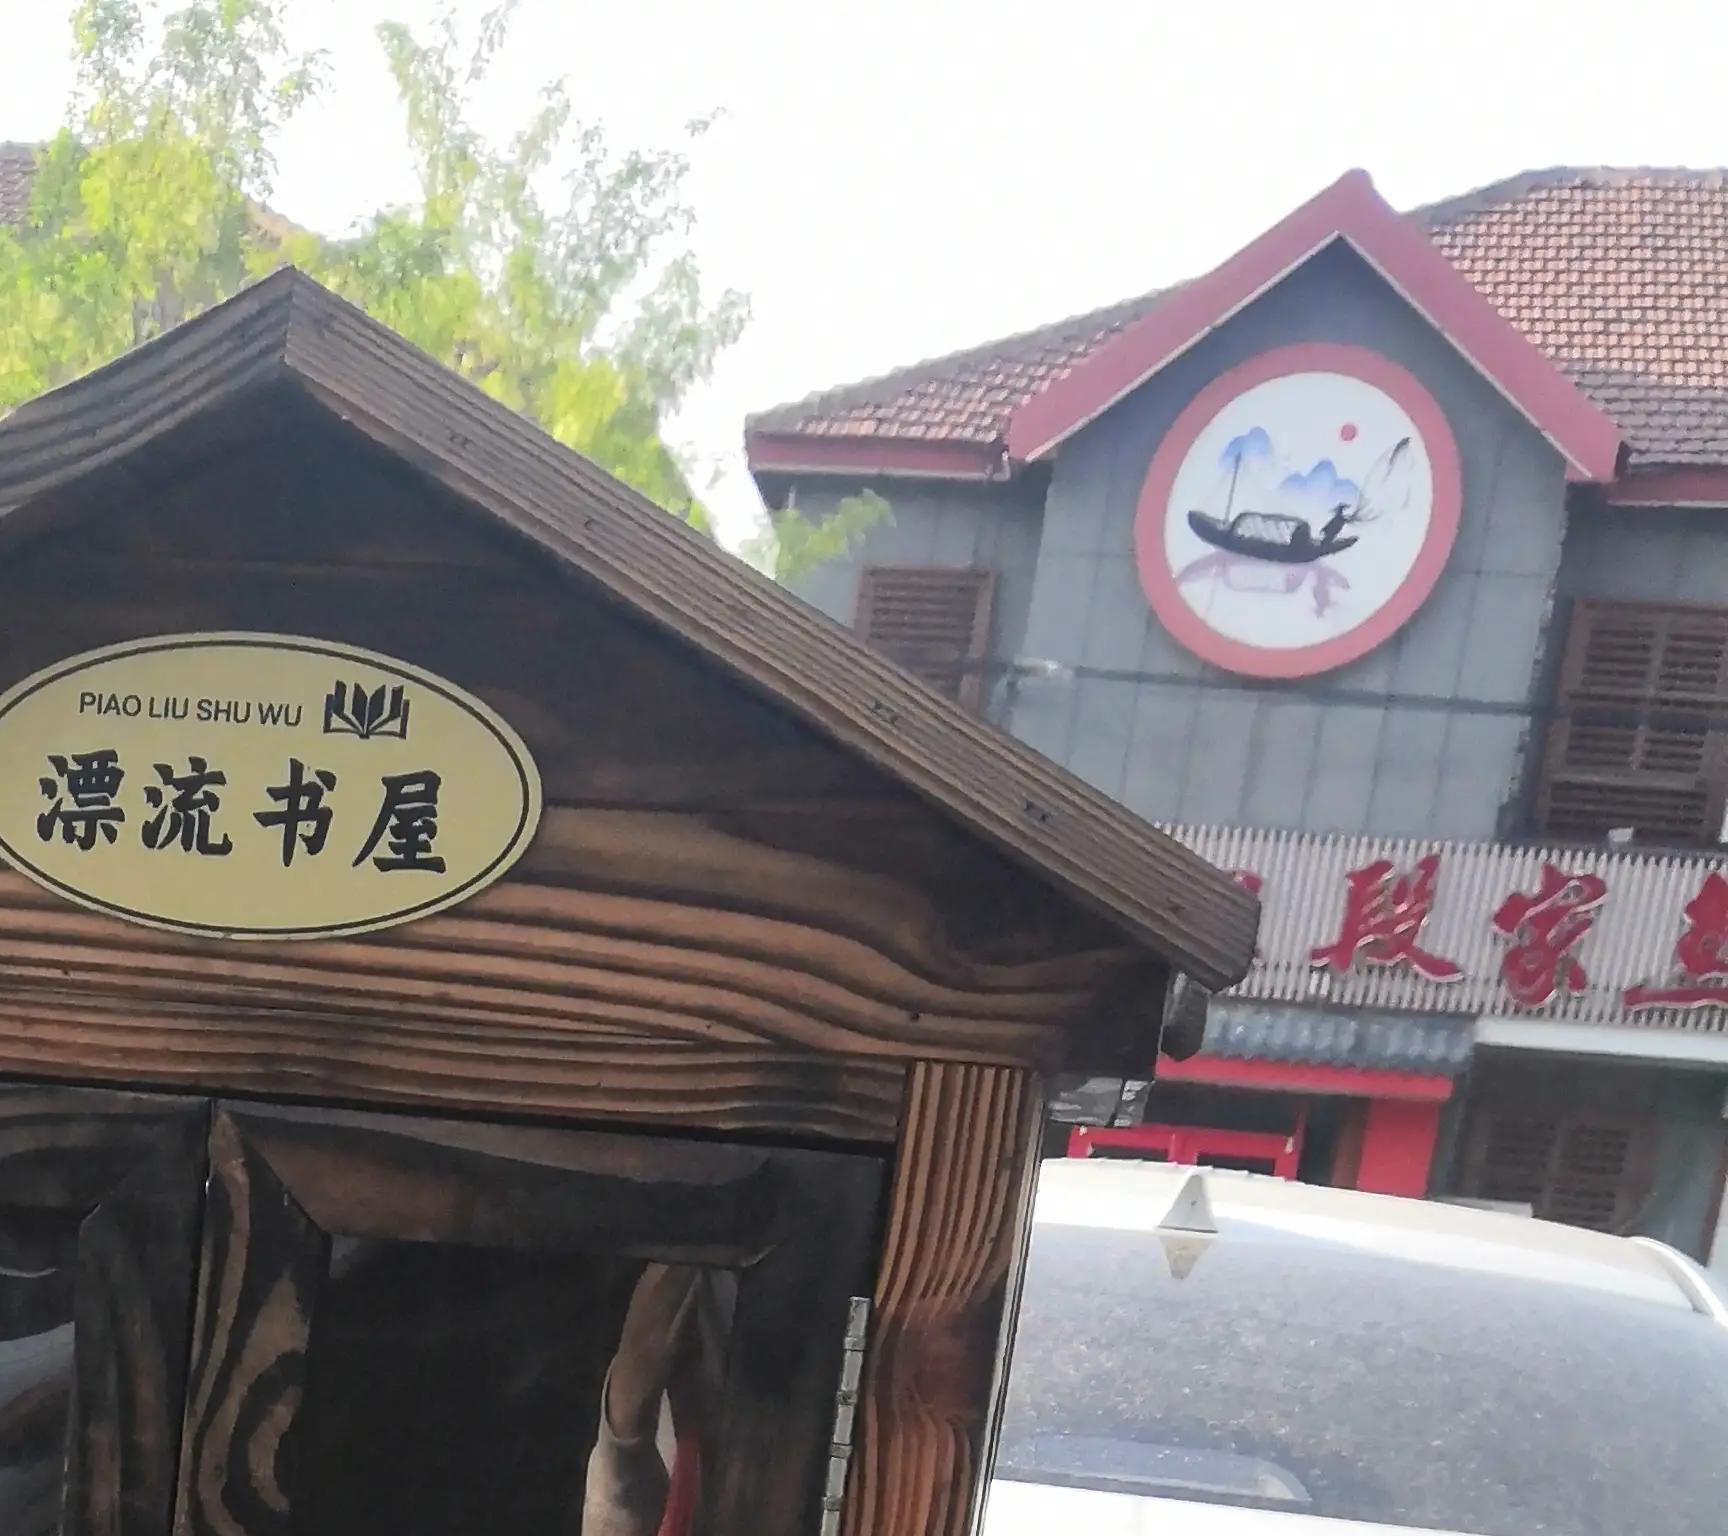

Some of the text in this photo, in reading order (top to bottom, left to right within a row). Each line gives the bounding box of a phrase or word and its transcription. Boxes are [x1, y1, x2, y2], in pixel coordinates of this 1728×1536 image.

[78, 691, 304, 727] PIAO LIU SHU WU
[35, 747, 448, 876] 漂流书屋
